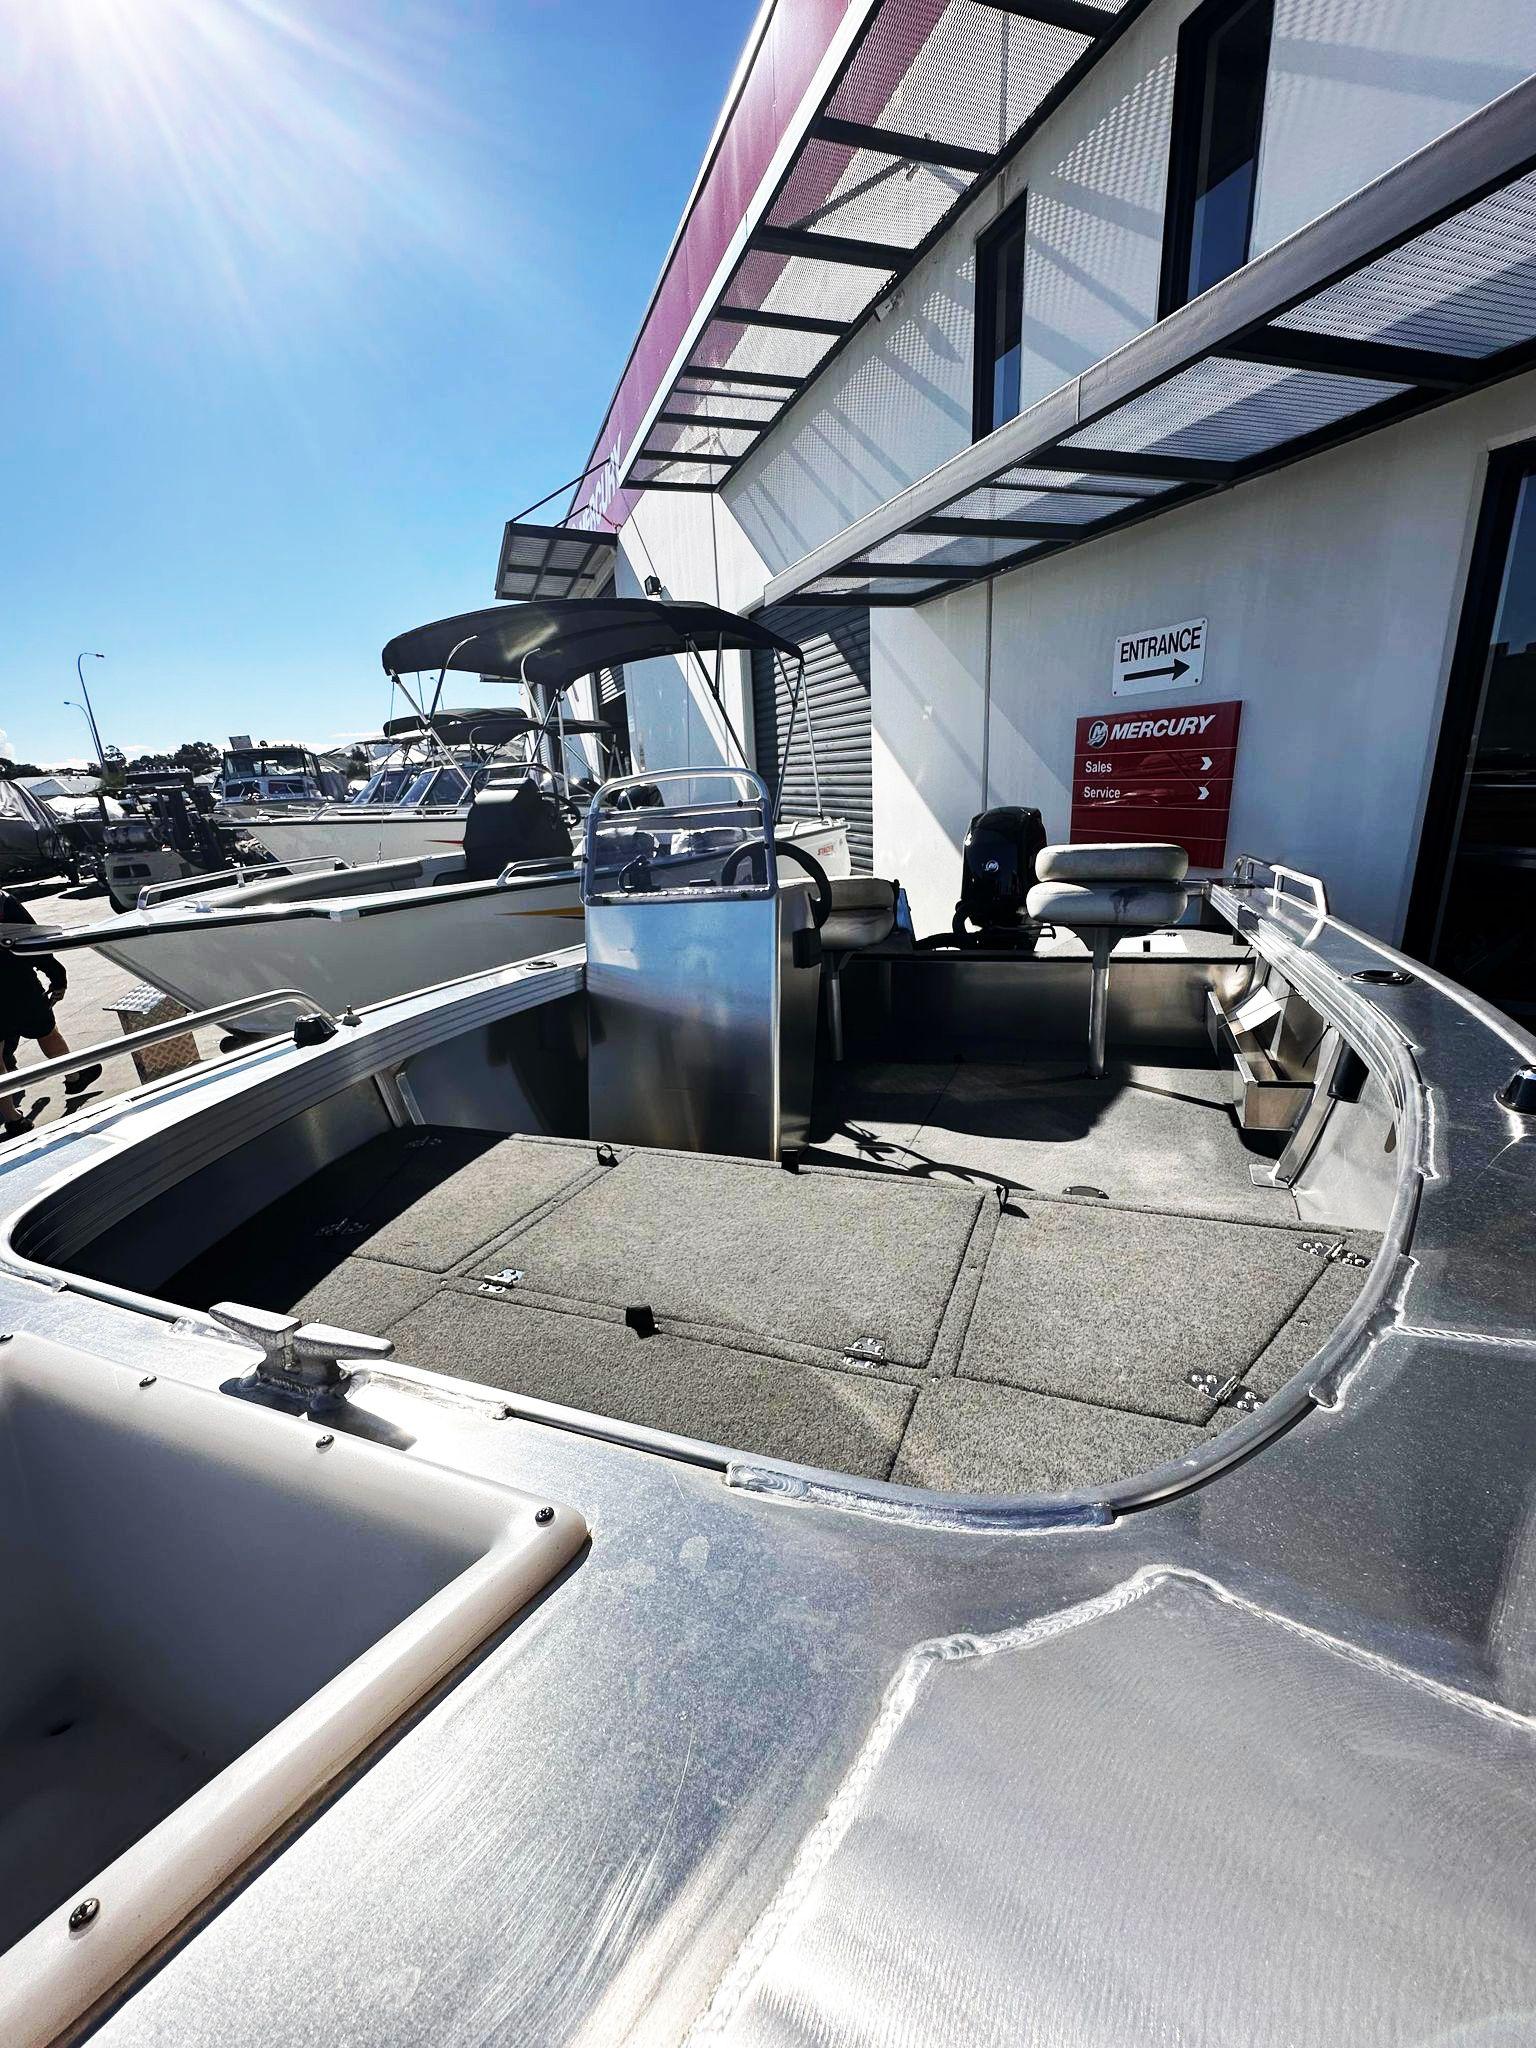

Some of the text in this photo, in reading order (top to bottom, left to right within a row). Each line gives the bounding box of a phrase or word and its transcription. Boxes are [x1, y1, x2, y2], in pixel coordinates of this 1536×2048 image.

[1120, 626, 1203, 663] ENTRANCE
[1110, 714, 1216, 740] MERCURY
[1085, 760, 1112, 773] Sales
[1083, 786, 1121, 799] Service
